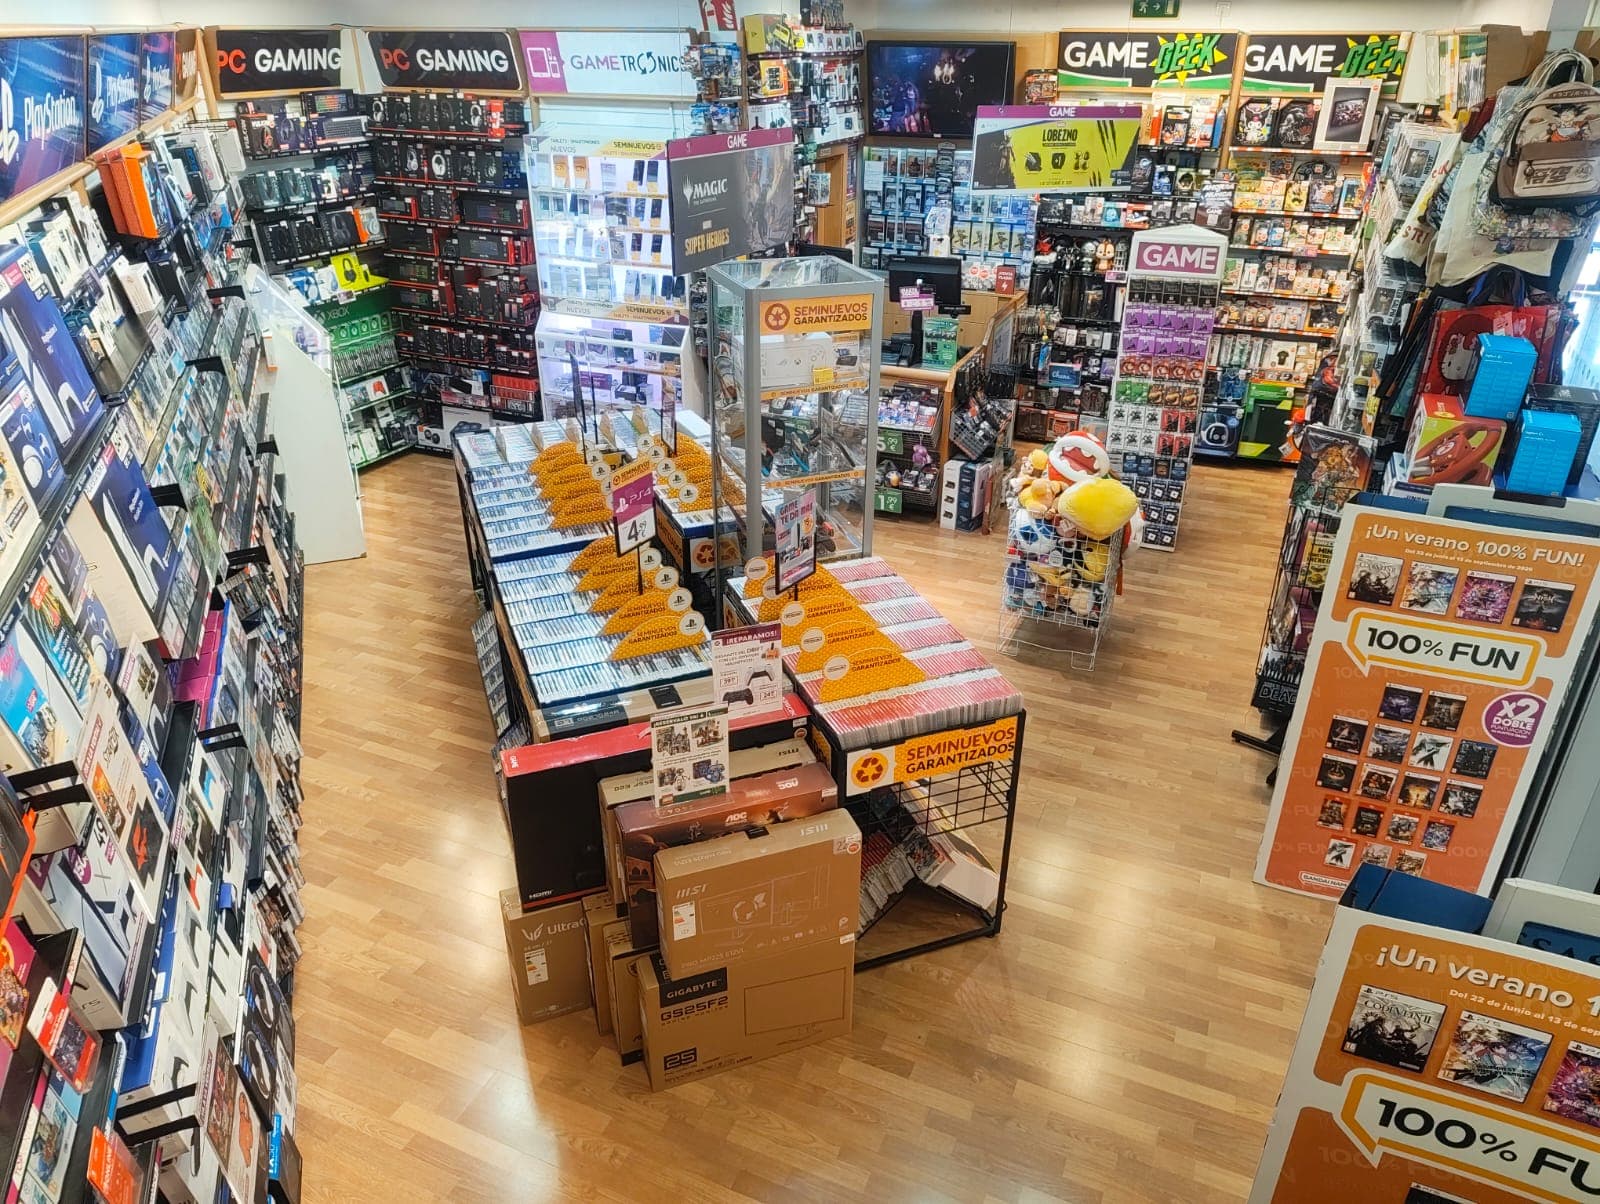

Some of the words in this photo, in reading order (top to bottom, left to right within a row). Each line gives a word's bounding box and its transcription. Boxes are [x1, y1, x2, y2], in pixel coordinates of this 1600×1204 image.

[217, 49, 247, 74] PC
[254, 46, 341, 73] GAMING
[380, 48, 410, 71] PC
[416, 48, 509, 73] GAMING
[1064, 41, 1150, 69] GAME
[1154, 34, 1222, 74] GEEK
[1245, 44, 1336, 73] GAME
[24, 89, 77, 151] PlayStation
[1049, 107, 1077, 118] GAME
[727, 134, 748, 149] GAME
[1042, 129, 1078, 142] LOBEZNO
[613, 141, 656, 150] SEMINUEVOS
[693, 179, 728, 199] MAGIC
[1143, 244, 1218, 270] GAME
[328, 306, 350, 321] XBOX
[626, 306, 666, 316] SEMINUEVOS
[794, 302, 868, 317] SEMINUEVOS
[794, 313, 868, 325] GARANTIZADOS
[629, 487, 652, 505] PS4
[1366, 522, 1399, 541] ¡Un
[1404, 530, 1470, 551] verano
[1476, 540, 1528, 560] 100%
[1532, 548, 1585, 567] FUN!
[619, 606, 666, 619] GARANTIZADOS
[807, 606, 853, 619] GARANTIZADOS
[808, 602, 845, 613] SEMINUEVOS
[629, 631, 678, 644] GARANTIZADOS
[637, 625, 677, 637] SEMINUEVOS
[827, 627, 867, 639] SEMINUEVOS
[827, 631, 875, 645] GARANTIZADOS
[1367, 627, 1445, 658] 100%
[1449, 641, 1521, 671] FUN
[852, 658, 901, 672] GARANTIZADOS
[853, 653, 893, 666] SEMINUEVOS
[1492, 717, 1534, 731] DOBLE
[906, 726, 1015, 762] SEMINUEVOS
[906, 741, 1015, 774] GARANTIZADOS
[725, 811, 748, 824] AOC
[1376, 944, 1437, 974] ¡Un
[1448, 960, 1574, 1009] verano
[667, 979, 719, 999] GIGABYTE
[660, 995, 729, 1023] GS25F2
[1450, 989, 1468, 1000] Del
[1470, 994, 1484, 1004] 22
[1486, 998, 1500, 1008] de
[1502, 1003, 1531, 1017] junio
[1533, 1010, 1545, 1020] al
[1548, 1014, 1561, 1025] 13
[1563, 1019, 1578, 1030] de
[666, 1050, 696, 1068] 25
[1378, 1098, 1518, 1162] 100%
[1527, 1147, 1600, 1197] FU
